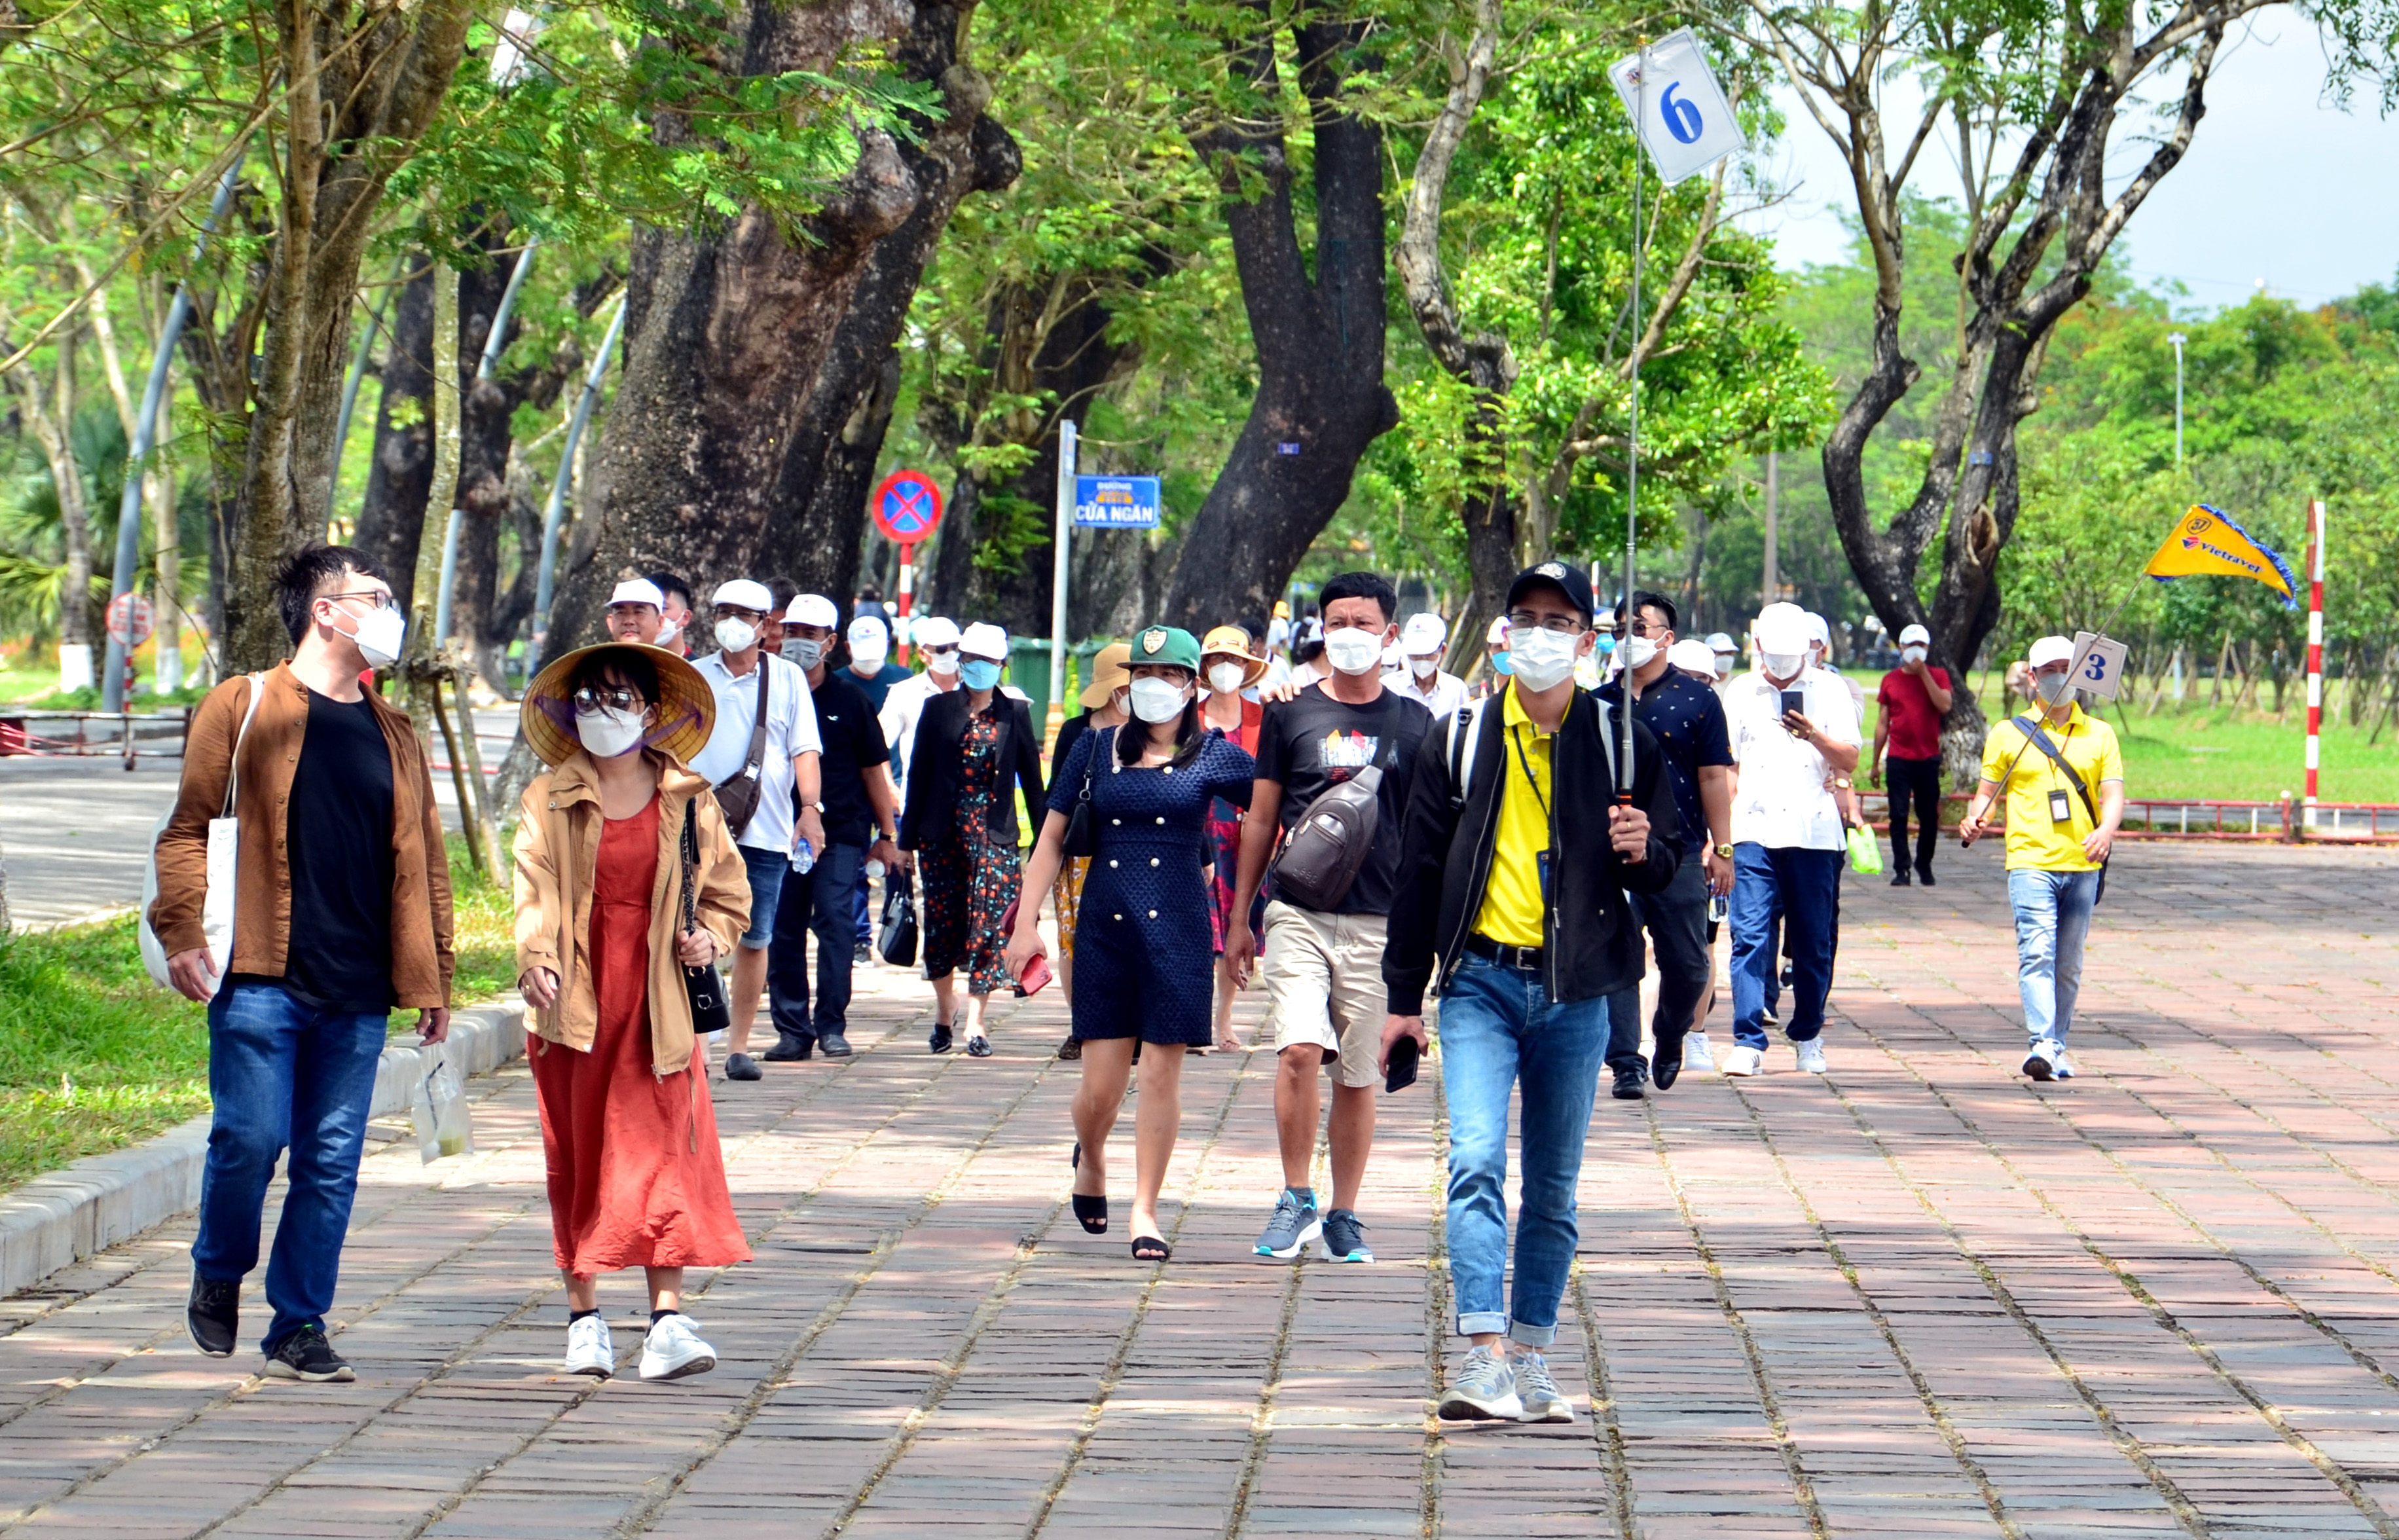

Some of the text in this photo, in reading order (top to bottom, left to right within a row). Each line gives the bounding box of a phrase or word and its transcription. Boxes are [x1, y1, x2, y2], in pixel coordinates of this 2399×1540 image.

[1660, 81, 1703, 144] 6
[1075, 501, 1107, 521] CỬA
[2201, 541, 2260, 573] Vietravel
[2085, 653, 2106, 680] 3
